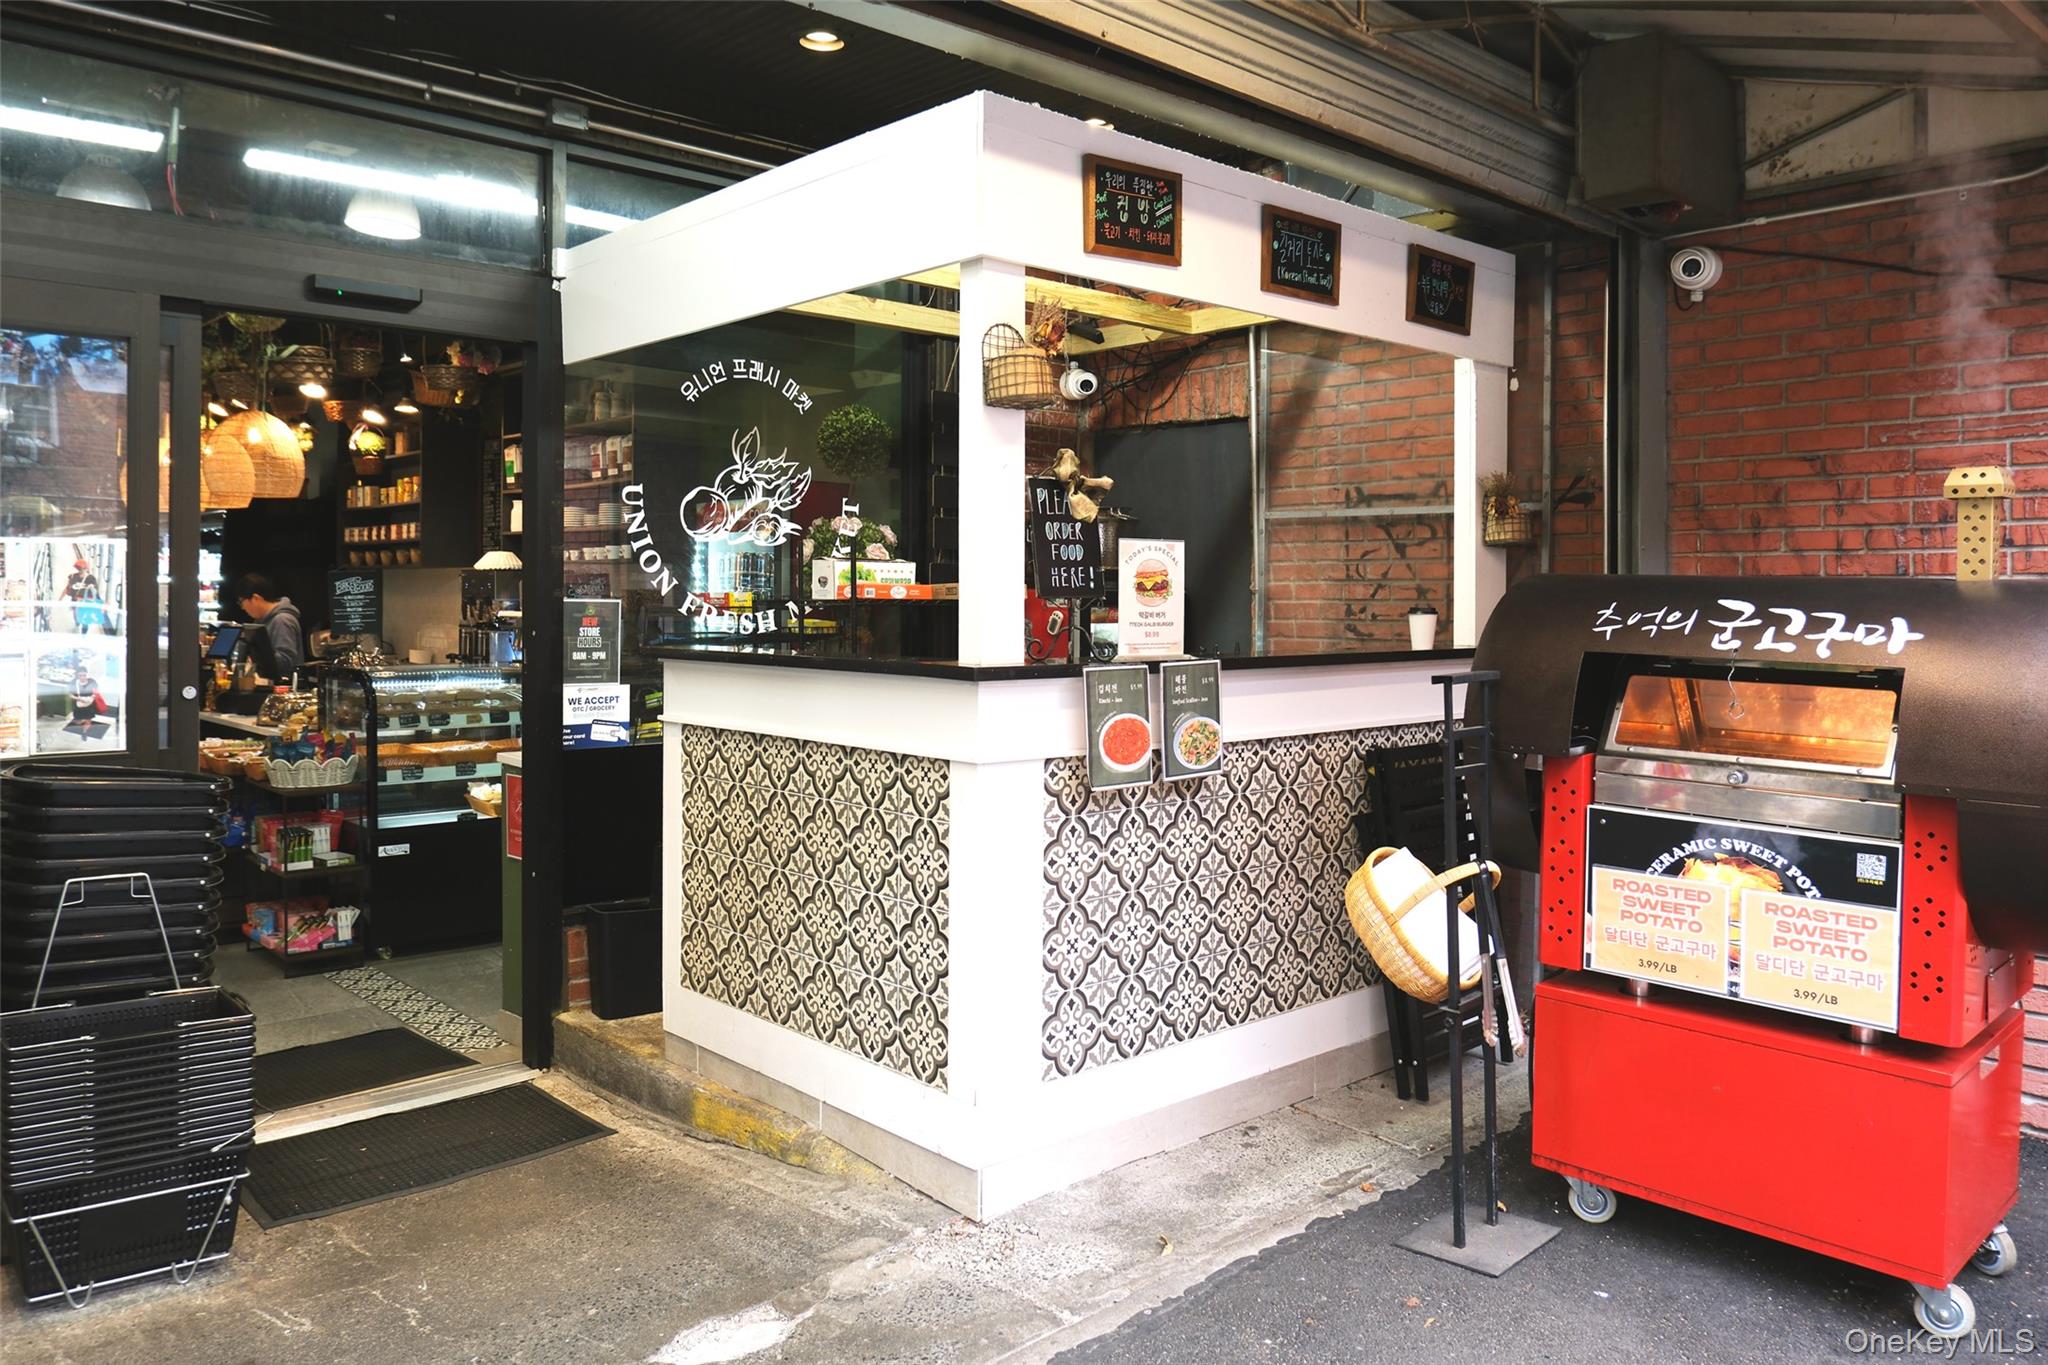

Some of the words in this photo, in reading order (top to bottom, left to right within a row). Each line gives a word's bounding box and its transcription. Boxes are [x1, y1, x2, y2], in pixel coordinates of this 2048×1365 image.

[1280, 233, 1304, 266] 길거리
[1306, 240, 1325, 270] 토스트
[680, 361, 728, 402] 유니언
[781, 378, 813, 415] 마켓
[1045, 521, 1083, 541] ORDER
[622, 483, 679, 596] UNION
[678, 591, 778, 635] FRESH
[1051, 543, 1084, 561] FOOD
[1125, 545, 1152, 565] TODAY'S
[1154, 545, 1179, 567] SPECIAL
[579, 627, 601, 637] STORE
[582, 616, 598, 627] NEW
[1592, 601, 1698, 641] 추억의
[1707, 599, 1925, 659] 군고구마
[578, 637, 602, 648] HOURS
[592, 652, 607, 660] 9PM
[568, 697, 582, 705] WE
[584, 696, 620, 705] ACCEPT
[1646, 837, 1717, 877] CERAMIC
[1720, 838, 1788, 869] SWEET
[1612, 878, 1712, 904] ROASTED
[1623, 895, 1701, 917] SWEET
[1764, 902, 1878, 930] ROASTED
[1620, 909, 1703, 933] POTATO
[1776, 920, 1866, 945] SWEET
[1605, 927, 1648, 947] 달디단
[1656, 935, 1716, 960] 군고구마
[1773, 935, 1868, 962] POTATO
[1638, 959, 1678, 973] 3.99/LB
[1756, 953, 1805, 977] 달디단
[1814, 963, 1883, 991] 군고구마
[1793, 988, 1839, 1005] 3.99/LB
